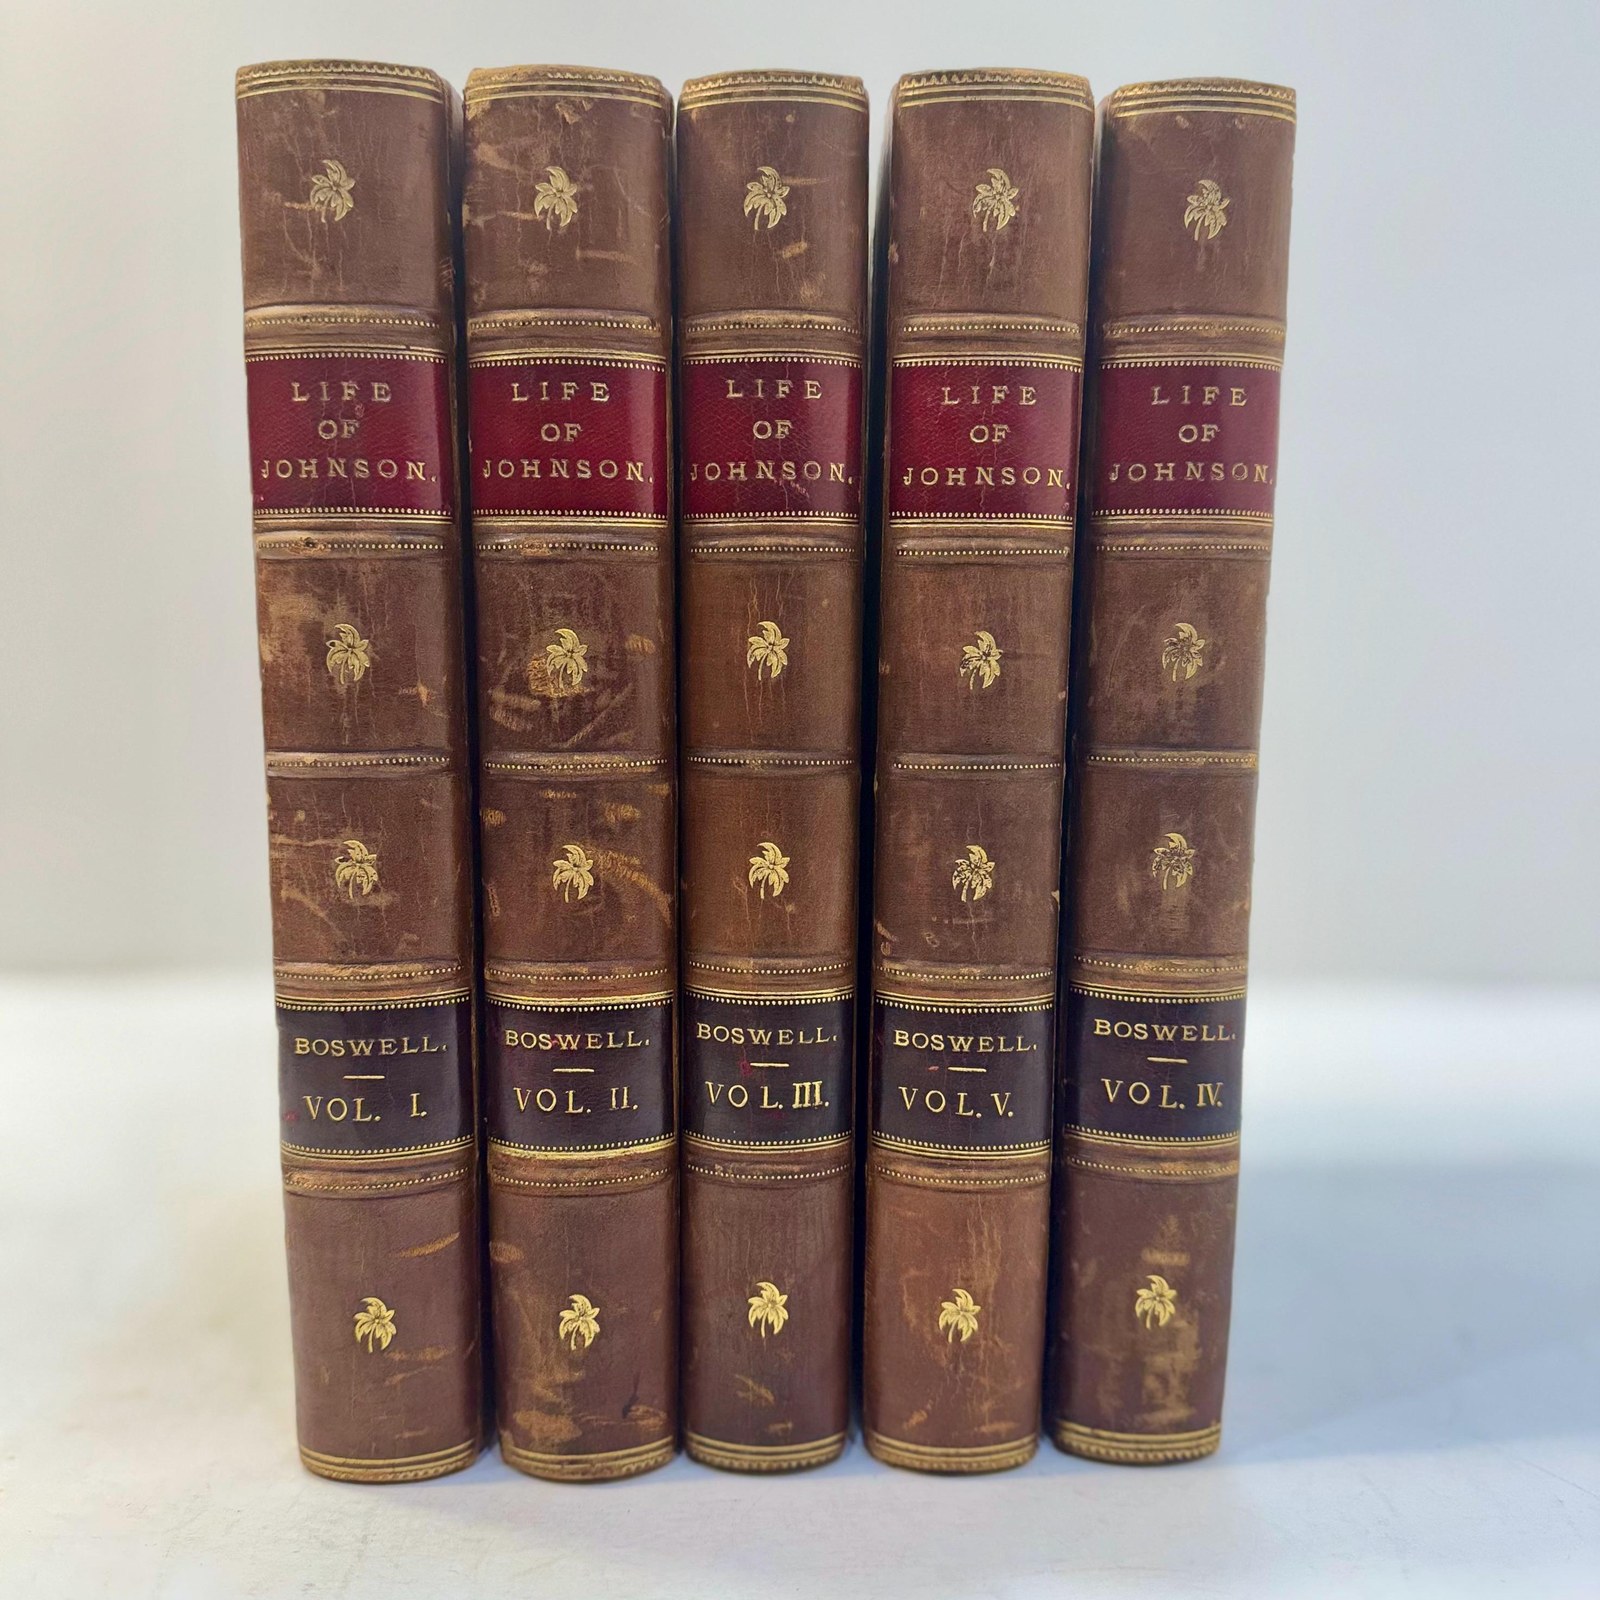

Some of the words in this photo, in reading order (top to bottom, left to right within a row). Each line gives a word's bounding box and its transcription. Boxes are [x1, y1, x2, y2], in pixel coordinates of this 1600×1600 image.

[291, 382, 392, 403] LIFE
[511, 382, 610, 402] LIFE
[726, 379, 823, 399] LIFE
[943, 386, 1038, 406] LIFE
[1151, 386, 1248, 407] LIFE
[318, 419, 360, 440] OF
[540, 423, 582, 442] OF
[752, 420, 792, 440] OF
[969, 424, 1009, 444] OF
[1178, 424, 1220, 444] OF
[261, 458, 437, 483] JOHNSON.
[482, 459, 653, 484] JOHNSON.
[690, 461, 854, 485] JOHNSON.
[902, 466, 1071, 490] JOHNSON.
[1109, 462, 1273, 485] JOHNSON.
[505, 1029, 650, 1050] BOSWELL.
[696, 1022, 838, 1046] BOSWELL.
[893, 1029, 1038, 1054] BOSWELL.
[1093, 1018, 1236, 1042] BOSWELL.
[294, 1036, 448, 1059] BOSWELL.
[513, 1087, 592, 1114] VOL.
[609, 1087, 639, 1111] II.
[704, 1080, 784, 1110] VOL.
[792, 1080, 829, 1108] III.
[899, 1086, 981, 1118] VOL.
[991, 1092, 1013, 1117] V.
[1101, 1078, 1185, 1110] VOL.
[1197, 1083, 1223, 1107] IV.
[303, 1095, 381, 1122] VOL.
[409, 1093, 428, 1118] I.
